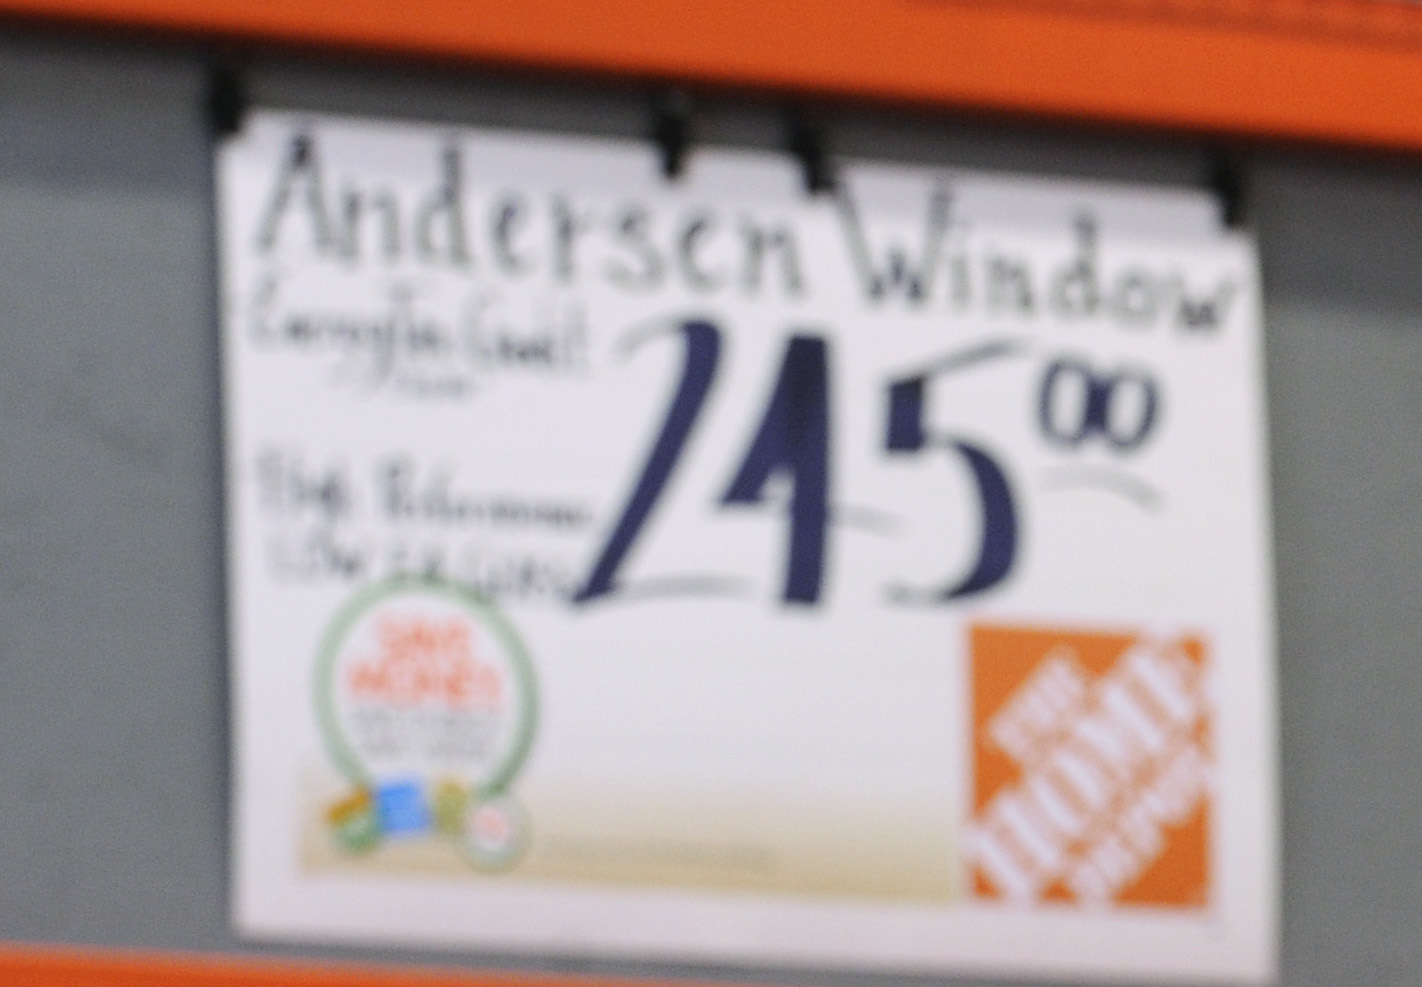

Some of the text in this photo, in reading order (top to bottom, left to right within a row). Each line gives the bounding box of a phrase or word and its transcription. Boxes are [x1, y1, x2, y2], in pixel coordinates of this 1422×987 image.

[254, 130, 1236, 335] Andersen Window
[568, 316, 1162, 608] 245 00
[962, 630, 1212, 902] HOME
